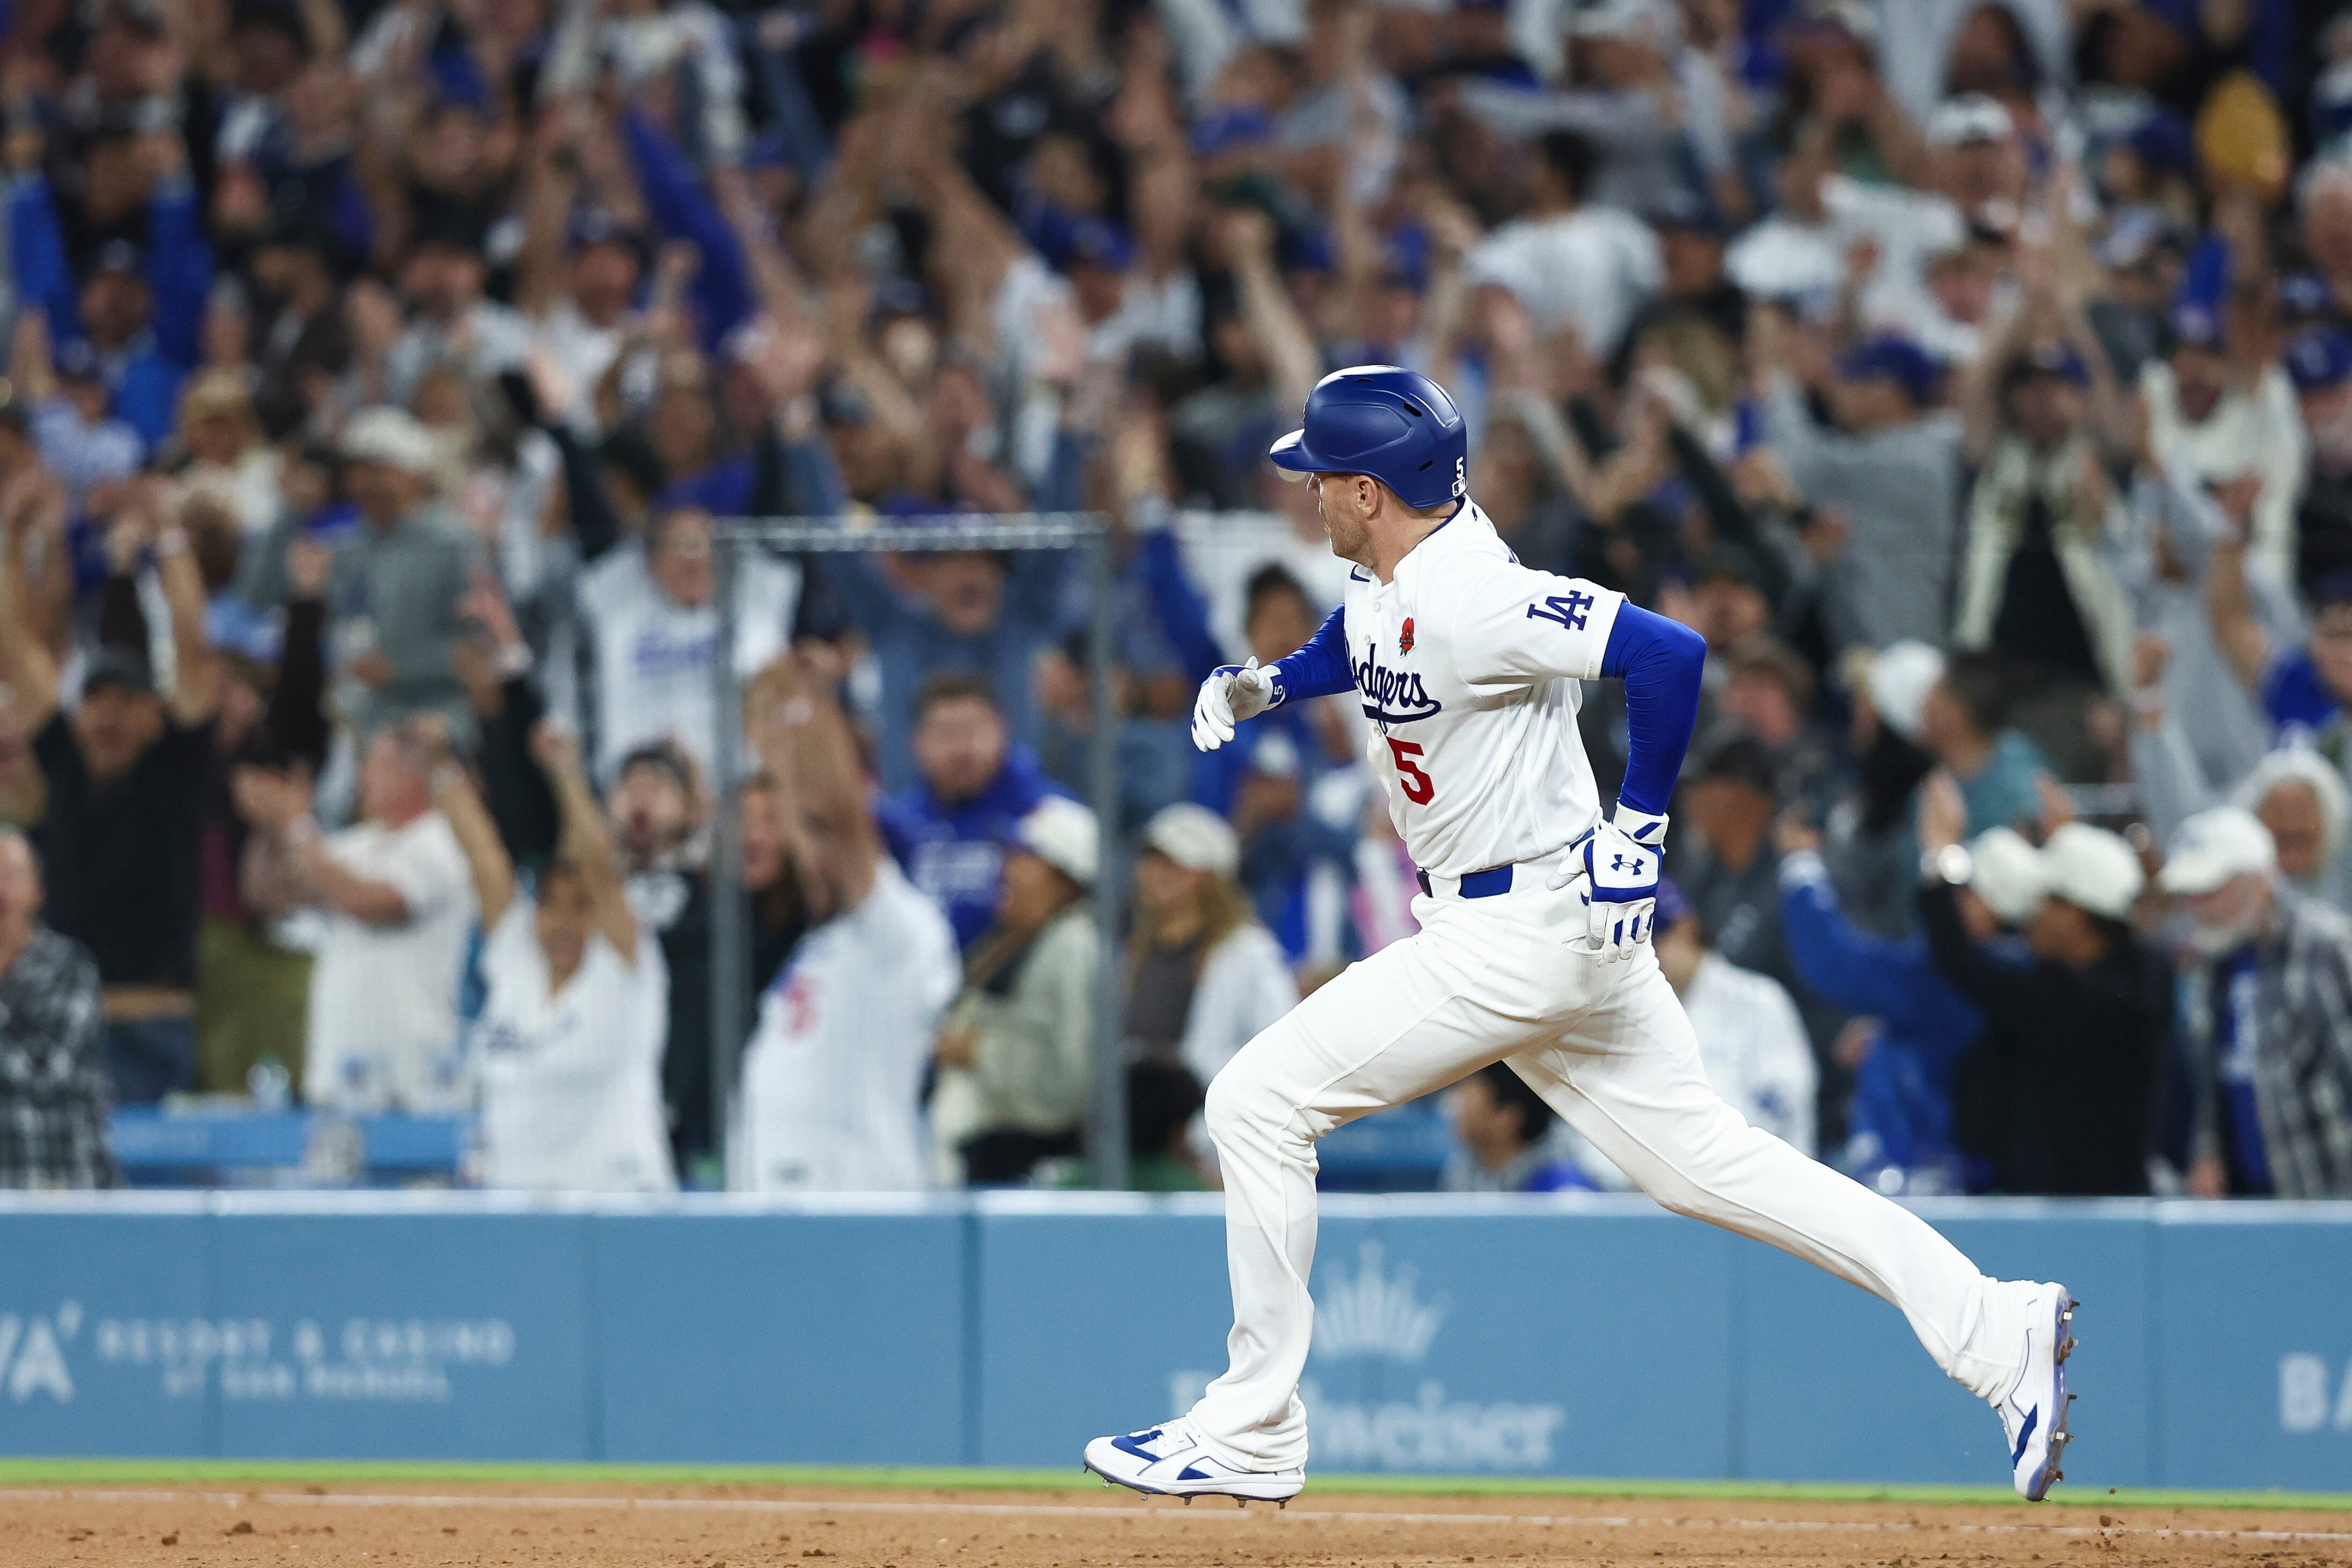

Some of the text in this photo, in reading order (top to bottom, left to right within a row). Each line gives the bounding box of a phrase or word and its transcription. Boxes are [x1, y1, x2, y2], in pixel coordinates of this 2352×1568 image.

[1456, 456, 1464, 479] 5
[1526, 589, 1594, 631] LA
[1273, 684, 1284, 695] 5
[1346, 643, 1442, 736] dgers
[1385, 735, 1435, 806] 5
